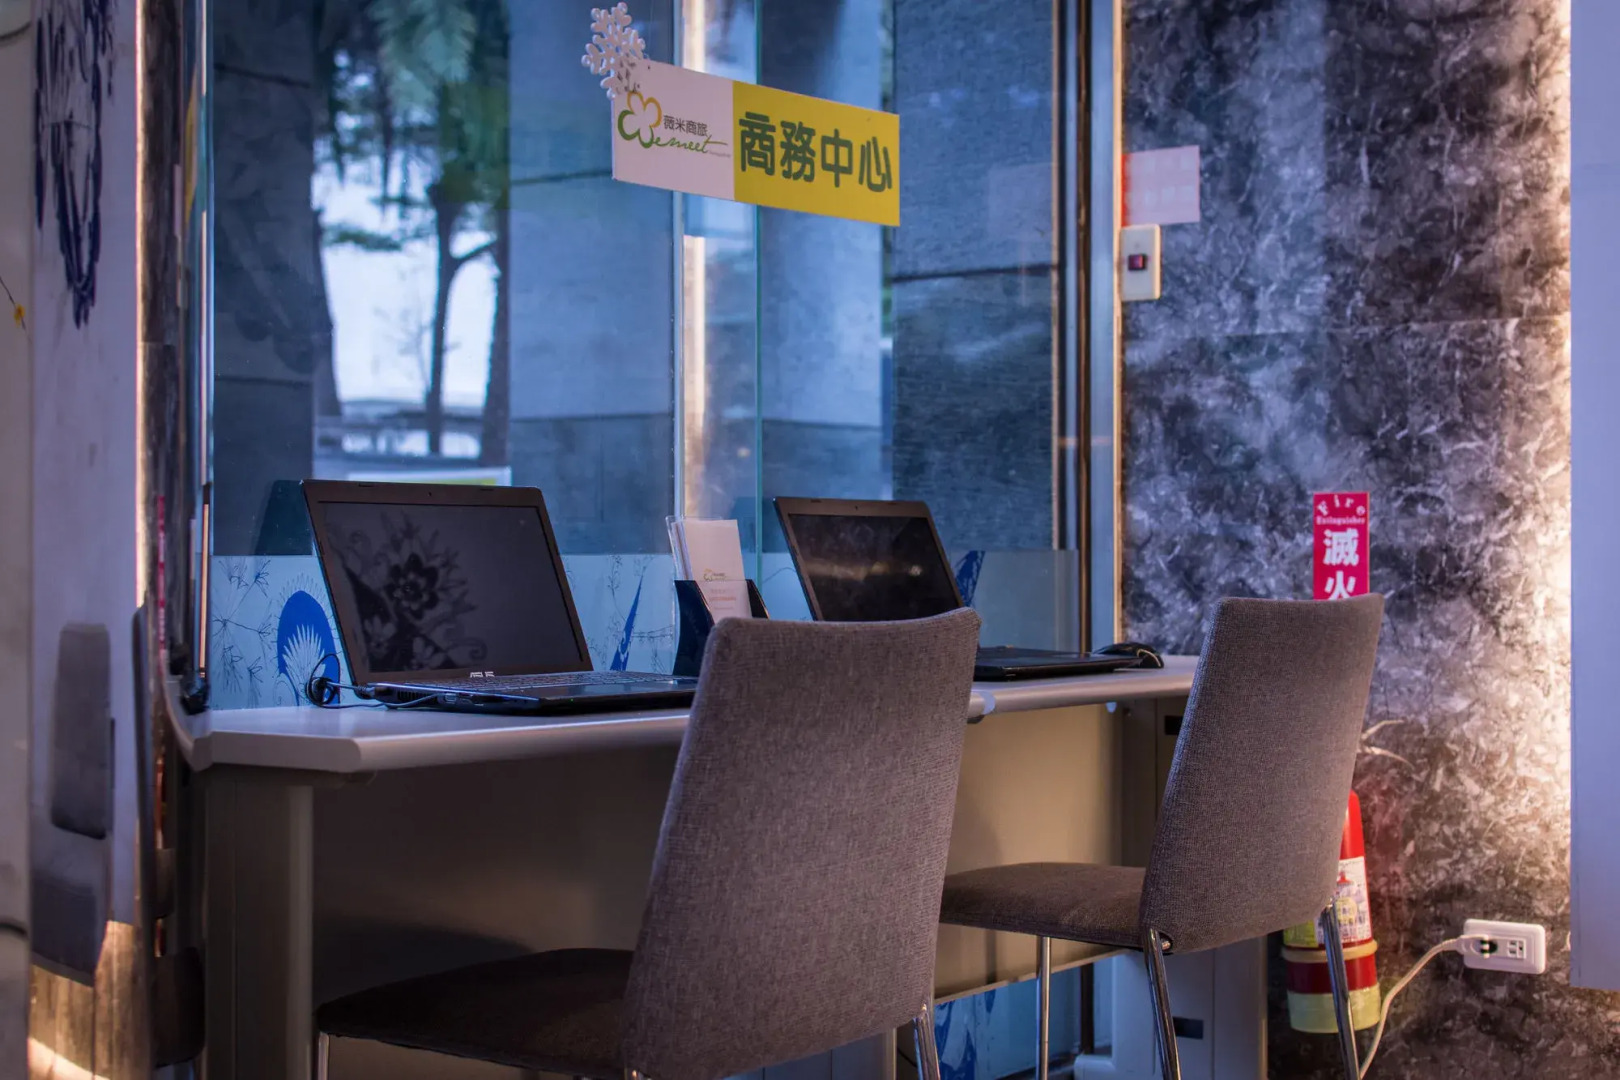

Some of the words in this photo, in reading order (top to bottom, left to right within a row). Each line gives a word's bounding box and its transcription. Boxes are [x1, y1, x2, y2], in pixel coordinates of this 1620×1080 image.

[739, 111, 892, 192] 商務中心
[1317, 494, 1366, 516] Fire
